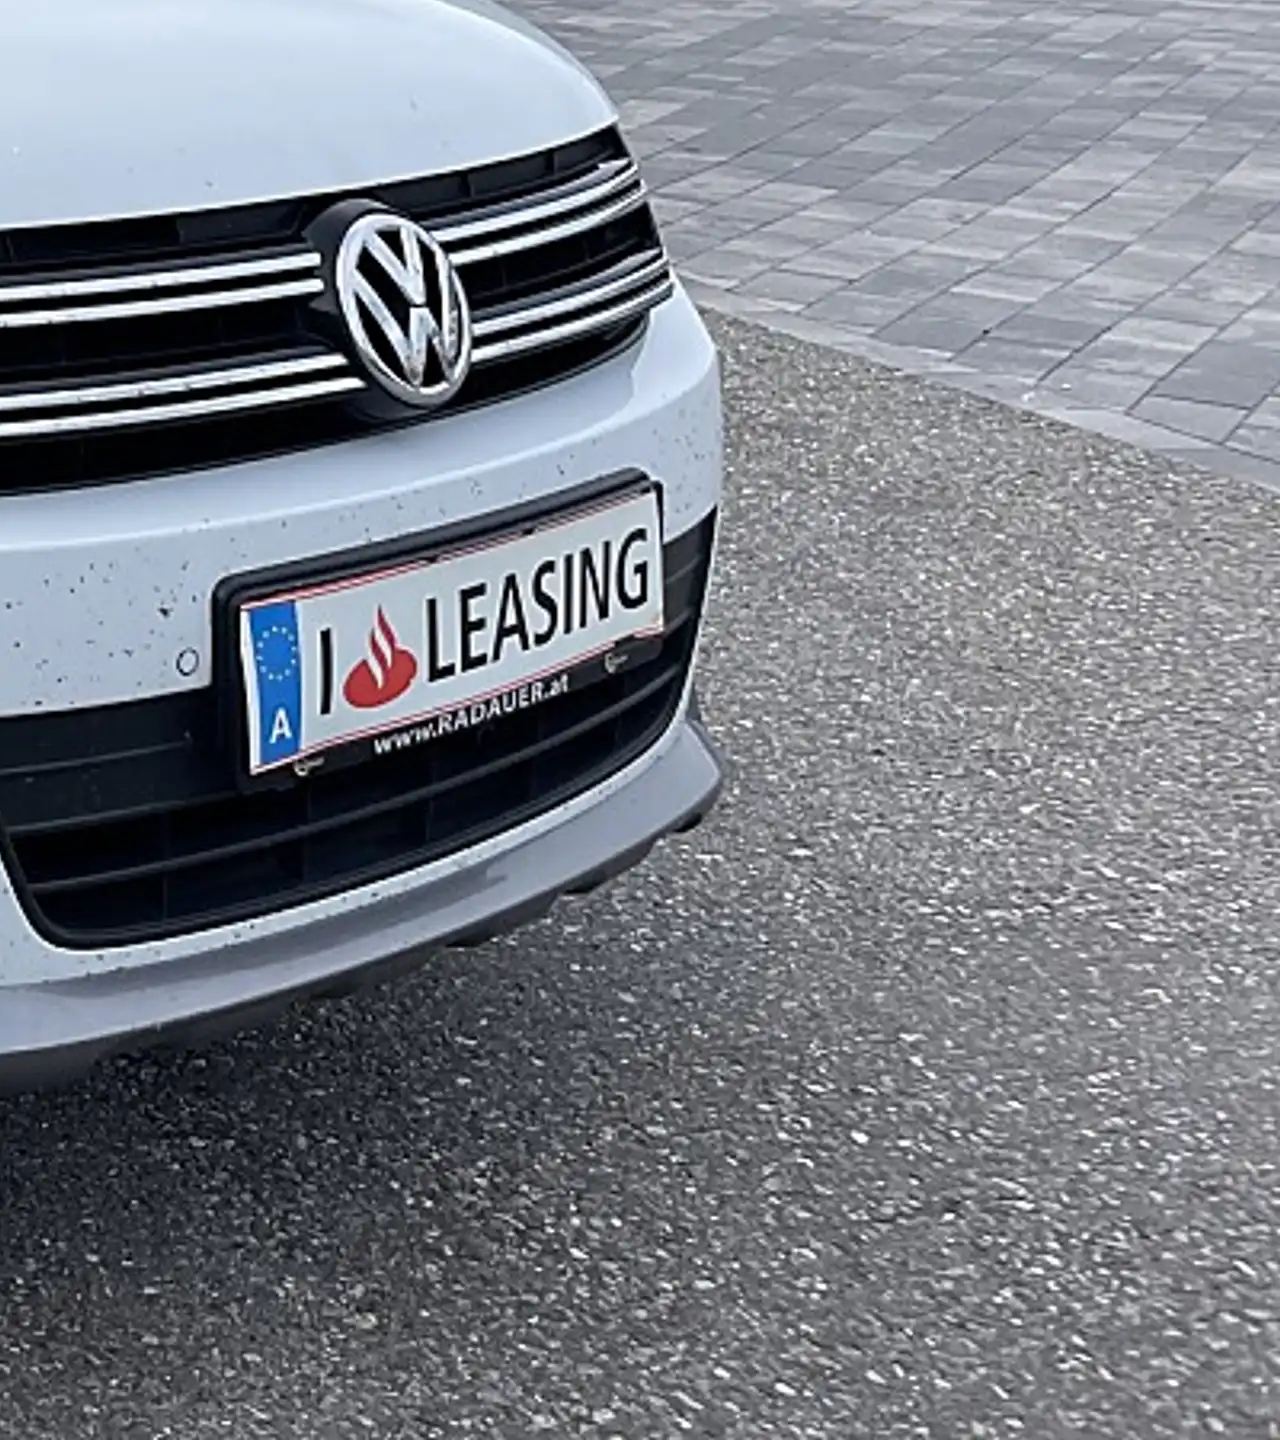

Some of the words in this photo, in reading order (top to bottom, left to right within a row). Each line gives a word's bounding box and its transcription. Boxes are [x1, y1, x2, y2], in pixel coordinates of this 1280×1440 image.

[426, 528, 649, 684] LEASING
[268, 708, 293, 744] A
[373, 674, 570, 755] www.RADAUER.at
